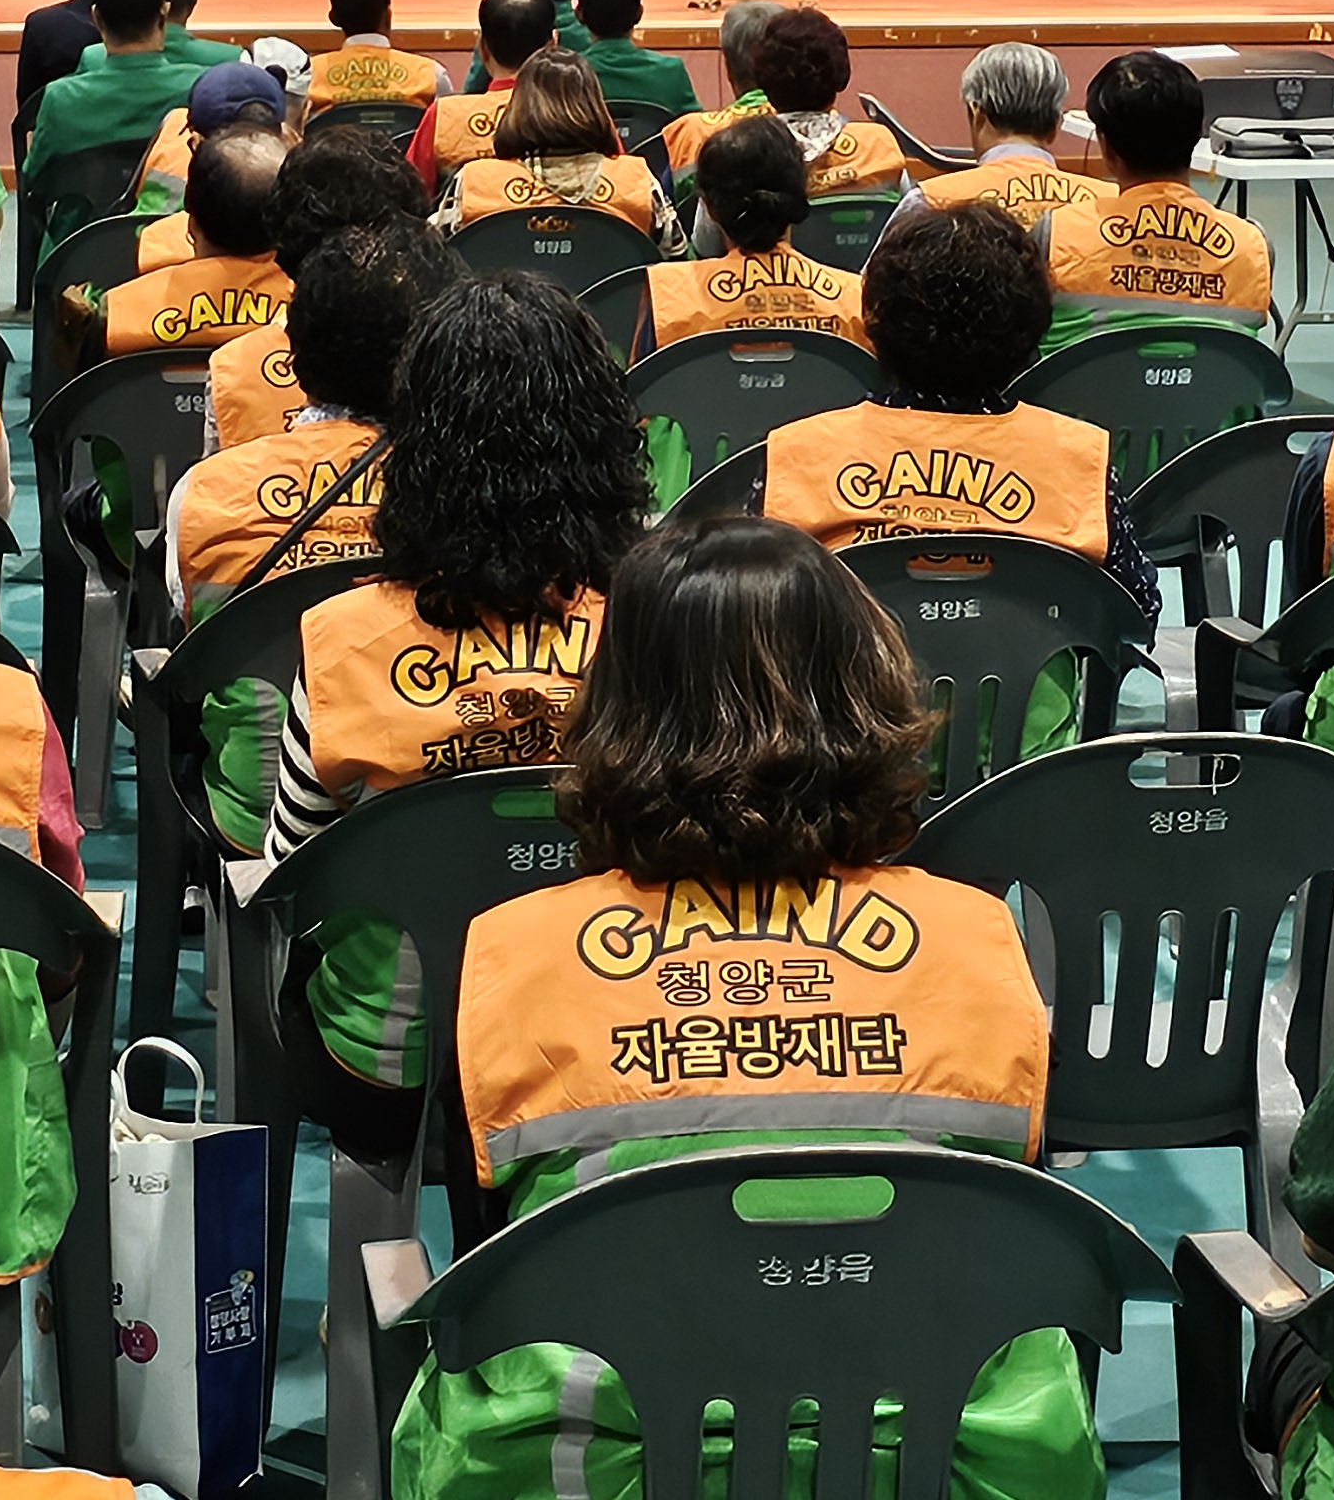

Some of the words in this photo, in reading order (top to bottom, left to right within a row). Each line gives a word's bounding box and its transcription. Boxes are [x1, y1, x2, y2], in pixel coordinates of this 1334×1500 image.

[1100, 203, 1236, 259] CAIND
[708, 253, 842, 302] CAIND
[1110, 265, 1226, 299] 자율방재단
[174, 393, 206, 414] 청양
[836, 448, 1036, 525] CAIND
[390, 612, 593, 708] CAIN
[1148, 808, 1230, 835] 청양읍
[576, 872, 921, 980] CAIND
[655, 958, 835, 1006] 청양군
[610, 1011, 909, 1084] 자율방재단
[756, 1251, 875, 1287] 청양읍
